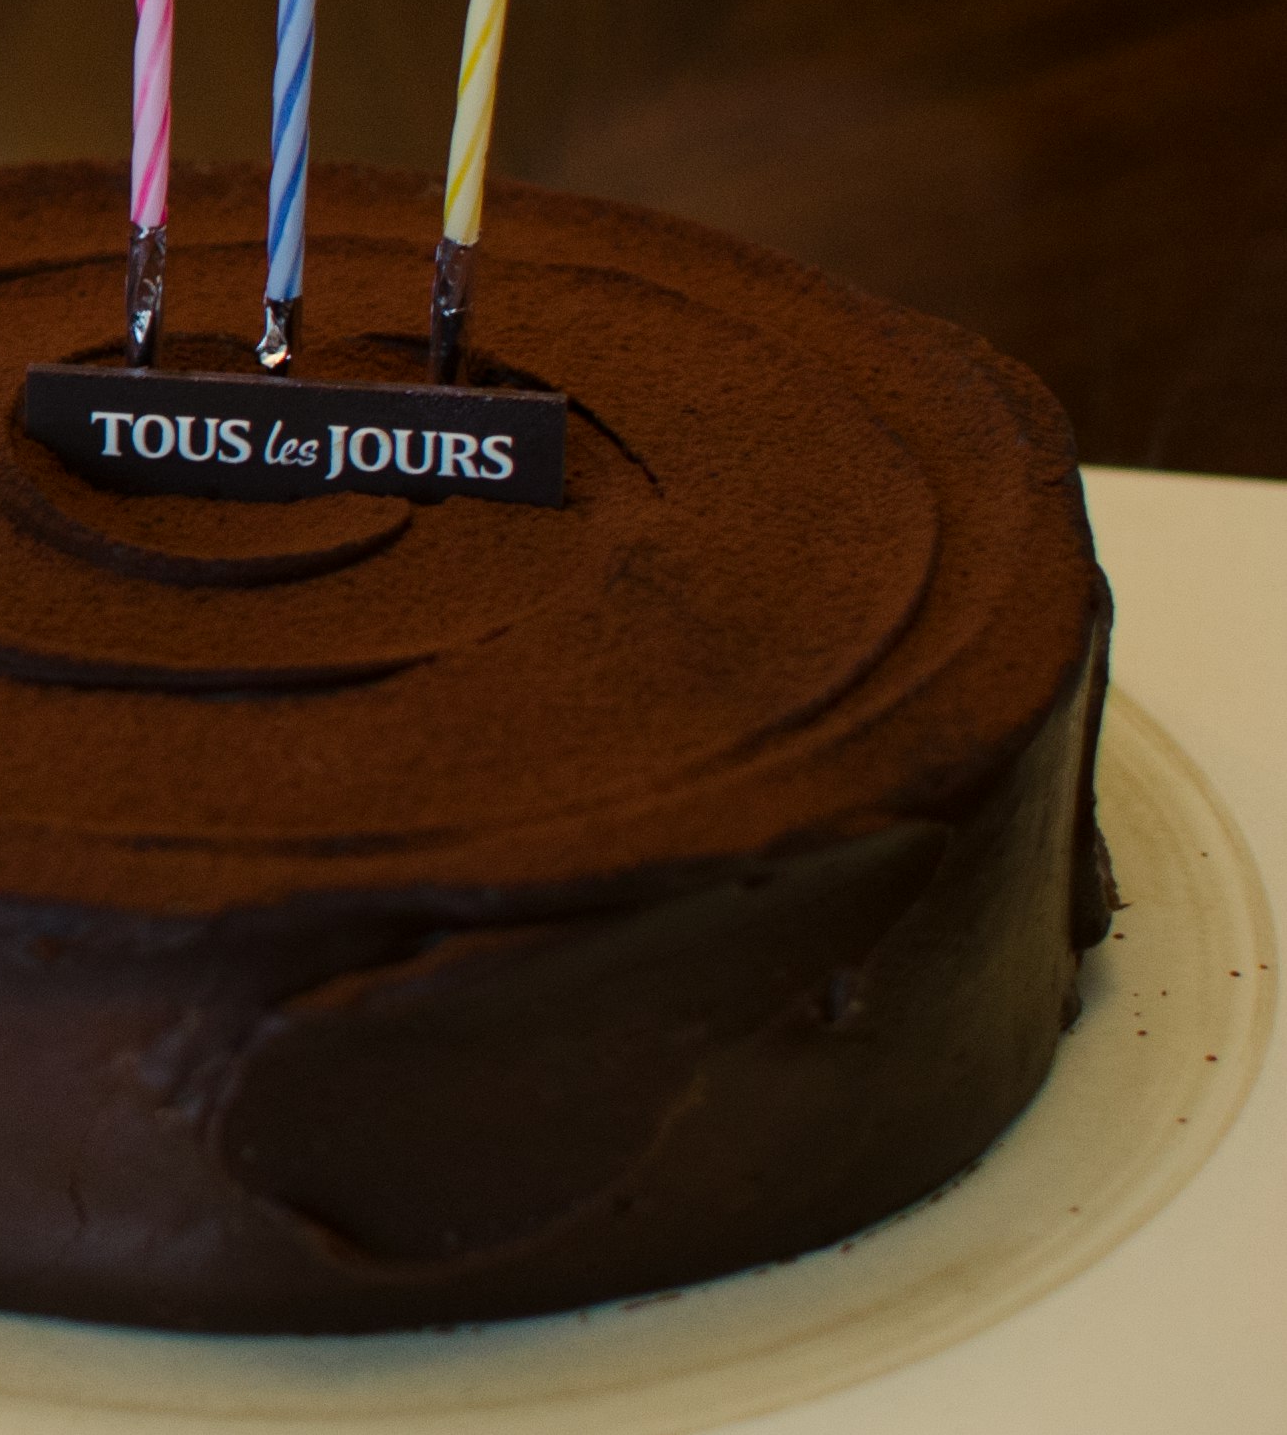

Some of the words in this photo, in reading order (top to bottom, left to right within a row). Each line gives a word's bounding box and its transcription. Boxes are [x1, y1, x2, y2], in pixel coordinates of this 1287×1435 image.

[90, 410, 253, 464] TOUS
[264, 419, 320, 467] les
[325, 424, 515, 481] JOURS
